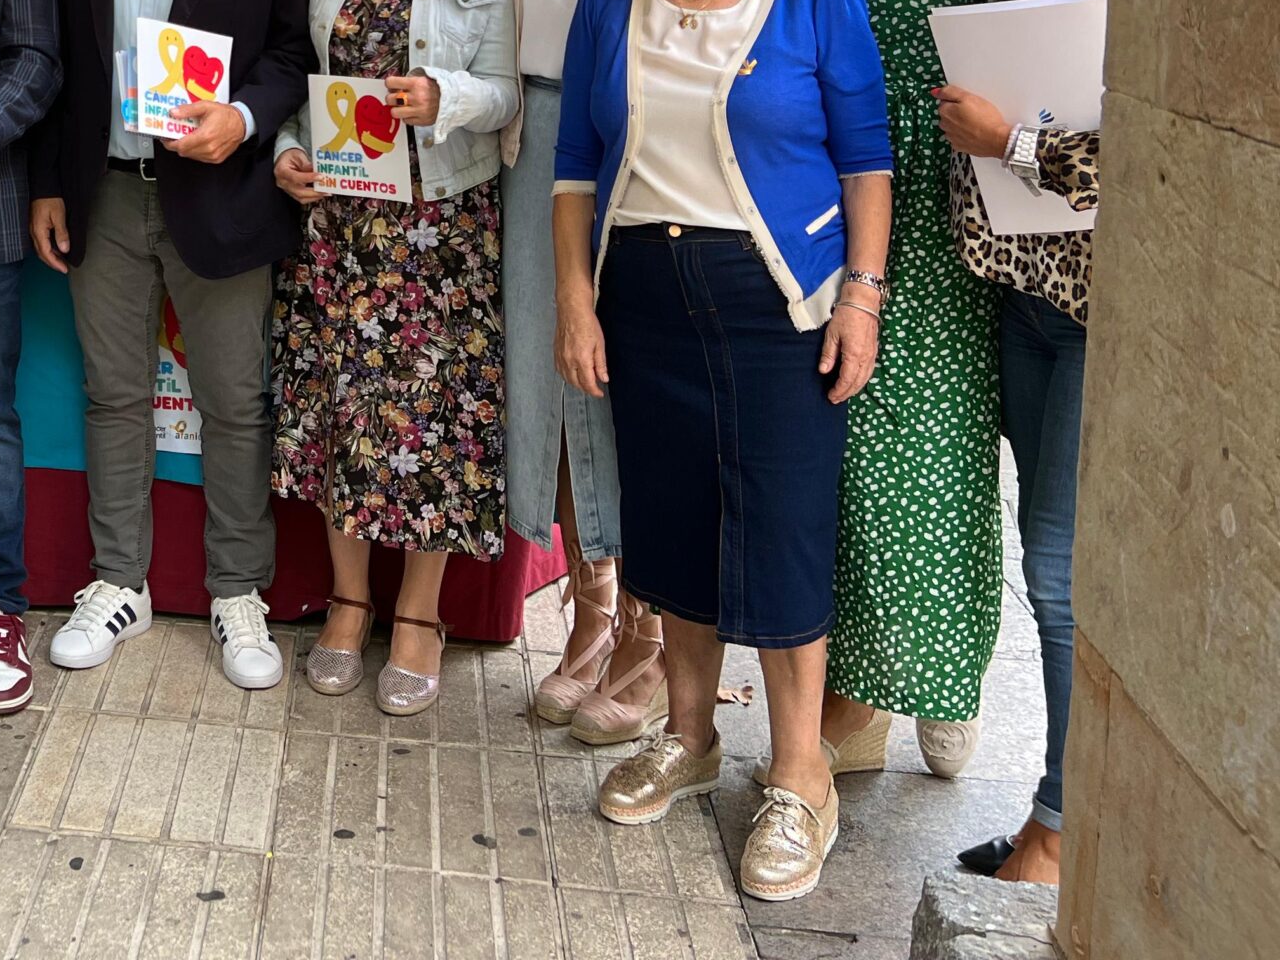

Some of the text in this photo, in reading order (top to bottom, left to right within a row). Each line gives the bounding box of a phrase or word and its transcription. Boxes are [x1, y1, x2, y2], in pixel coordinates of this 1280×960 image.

[167, 122, 195, 135] CUEN
[340, 179, 397, 194] CUENTOS
[152, 396, 193, 411] UENT
